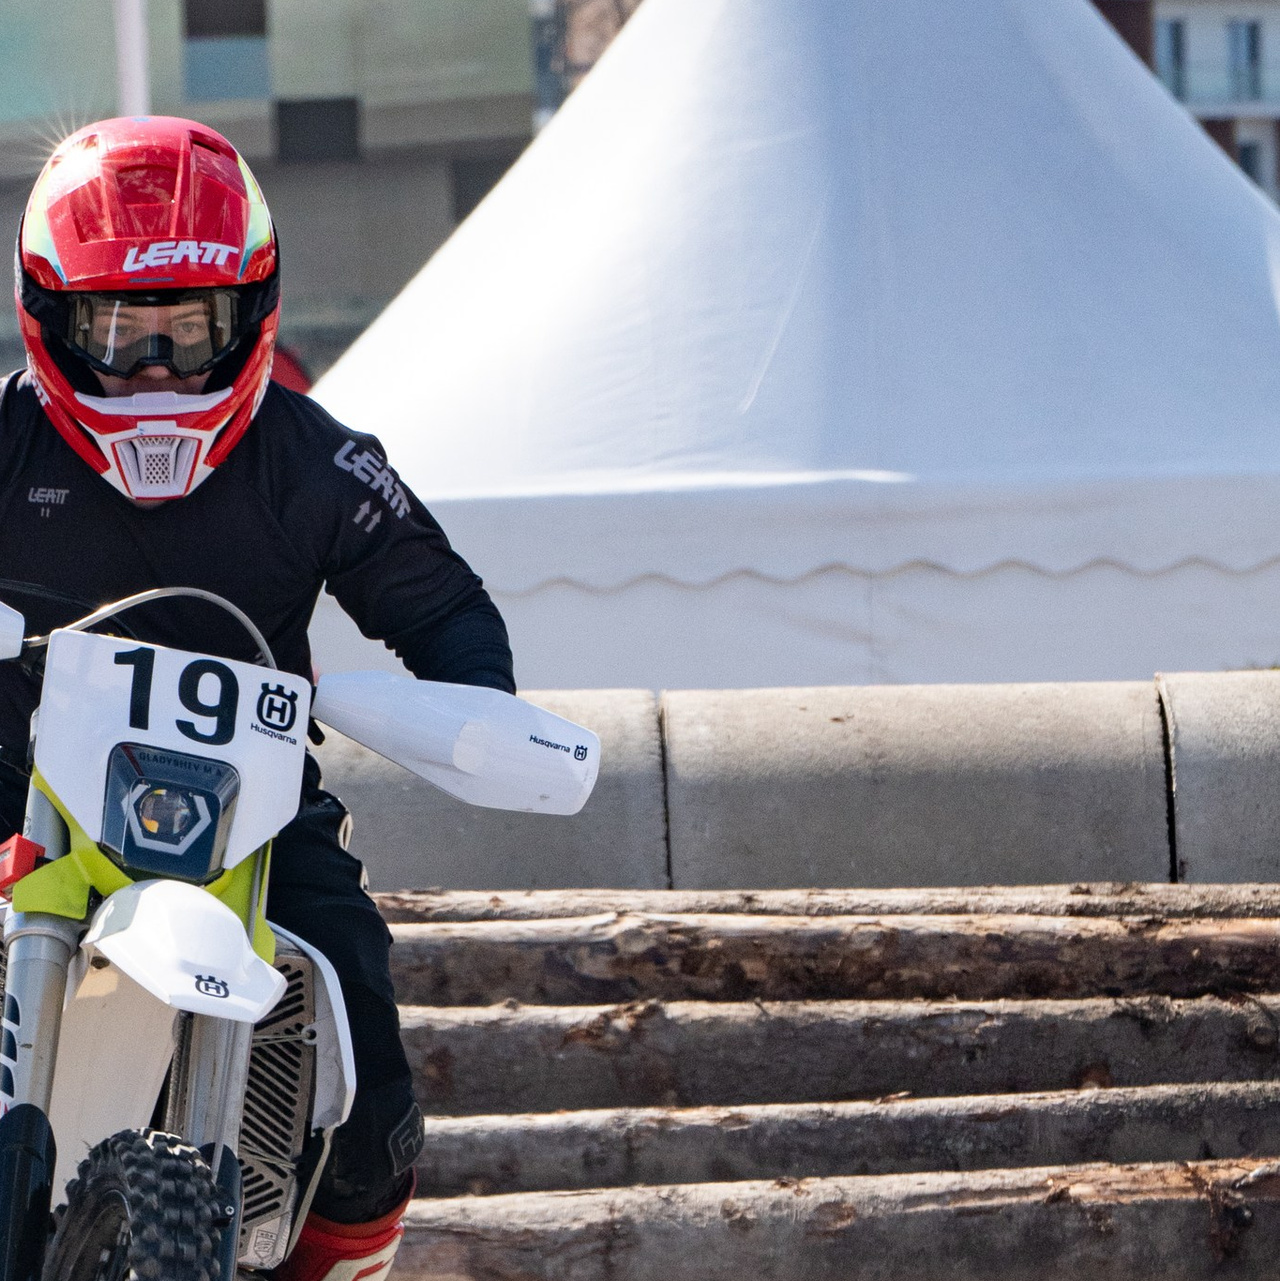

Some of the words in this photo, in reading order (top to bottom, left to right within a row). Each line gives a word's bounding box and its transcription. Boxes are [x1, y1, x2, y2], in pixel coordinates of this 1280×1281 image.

[123, 240, 239, 272] LEATT
[333, 439, 412, 519] LEATT
[28, 487, 70, 505] LEATT
[114, 646, 239, 746] 19
[250, 722, 297, 746] Husqvarna
[529, 734, 571, 754] Husqvarna
